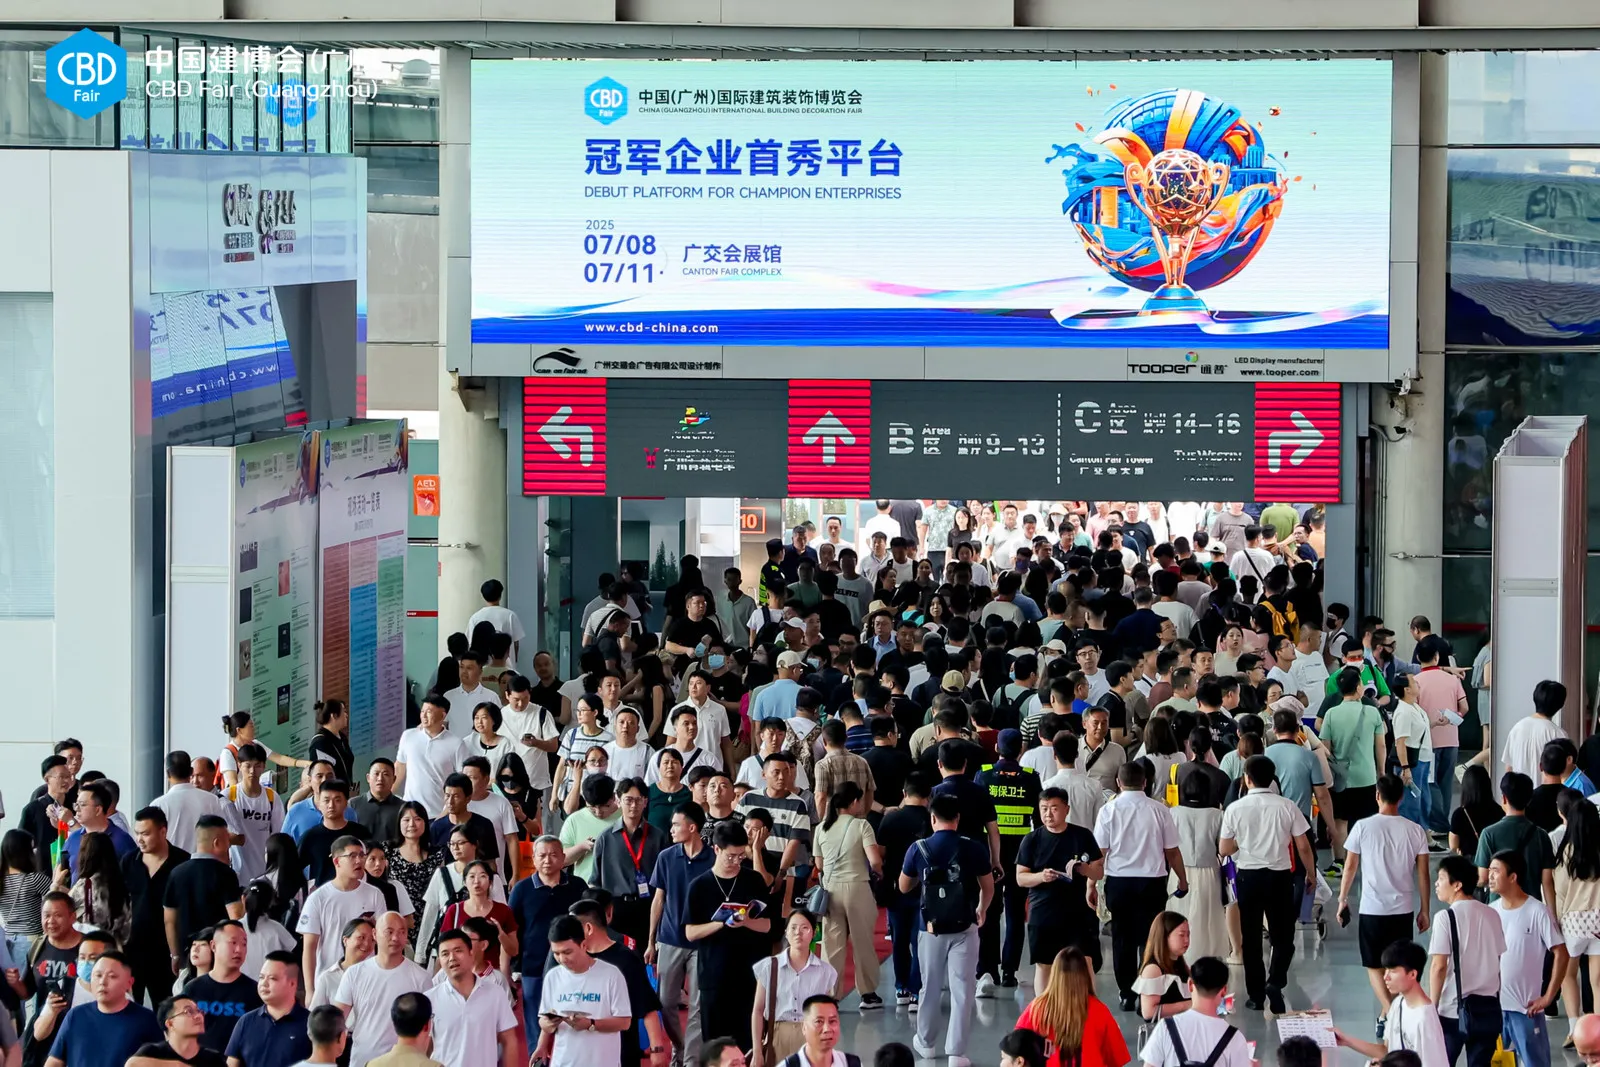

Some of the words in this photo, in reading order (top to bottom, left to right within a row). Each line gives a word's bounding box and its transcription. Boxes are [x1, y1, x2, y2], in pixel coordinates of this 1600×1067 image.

[590, 89, 623, 109] CBD
[638, 89, 863, 105] 中国(广州)国际建筑装饰博览会
[598, 109, 615, 118] Fair
[585, 137, 904, 177] 冠军企业首秀平台
[584, 186, 628, 199] DEBUT
[633, 186, 703, 199] PLATFORM
[708, 186, 735, 199] FOR
[739, 186, 811, 199] CHAMPION
[815, 186, 902, 200] ENTERPRISES
[585, 219, 615, 231] 2025
[584, 234, 657, 256] 07/08
[683, 244, 782, 264] 广交会展馆
[584, 262, 654, 284] 07/11
[682, 267, 719, 276] CANTON
[721, 267, 739, 276] FAIR
[741, 267, 782, 276] COMPLEX
[584, 322, 719, 335] www.cbd-china.com
[1249, 357, 1276, 365] Display
[1240, 368, 1319, 377] www.tooper.com
[1074, 401, 1102, 434] C
[888, 422, 915, 455] B
[416, 479, 436, 488] AED
[740, 513, 758, 529] 10
[988, 785, 1027, 798] 海保卫士
